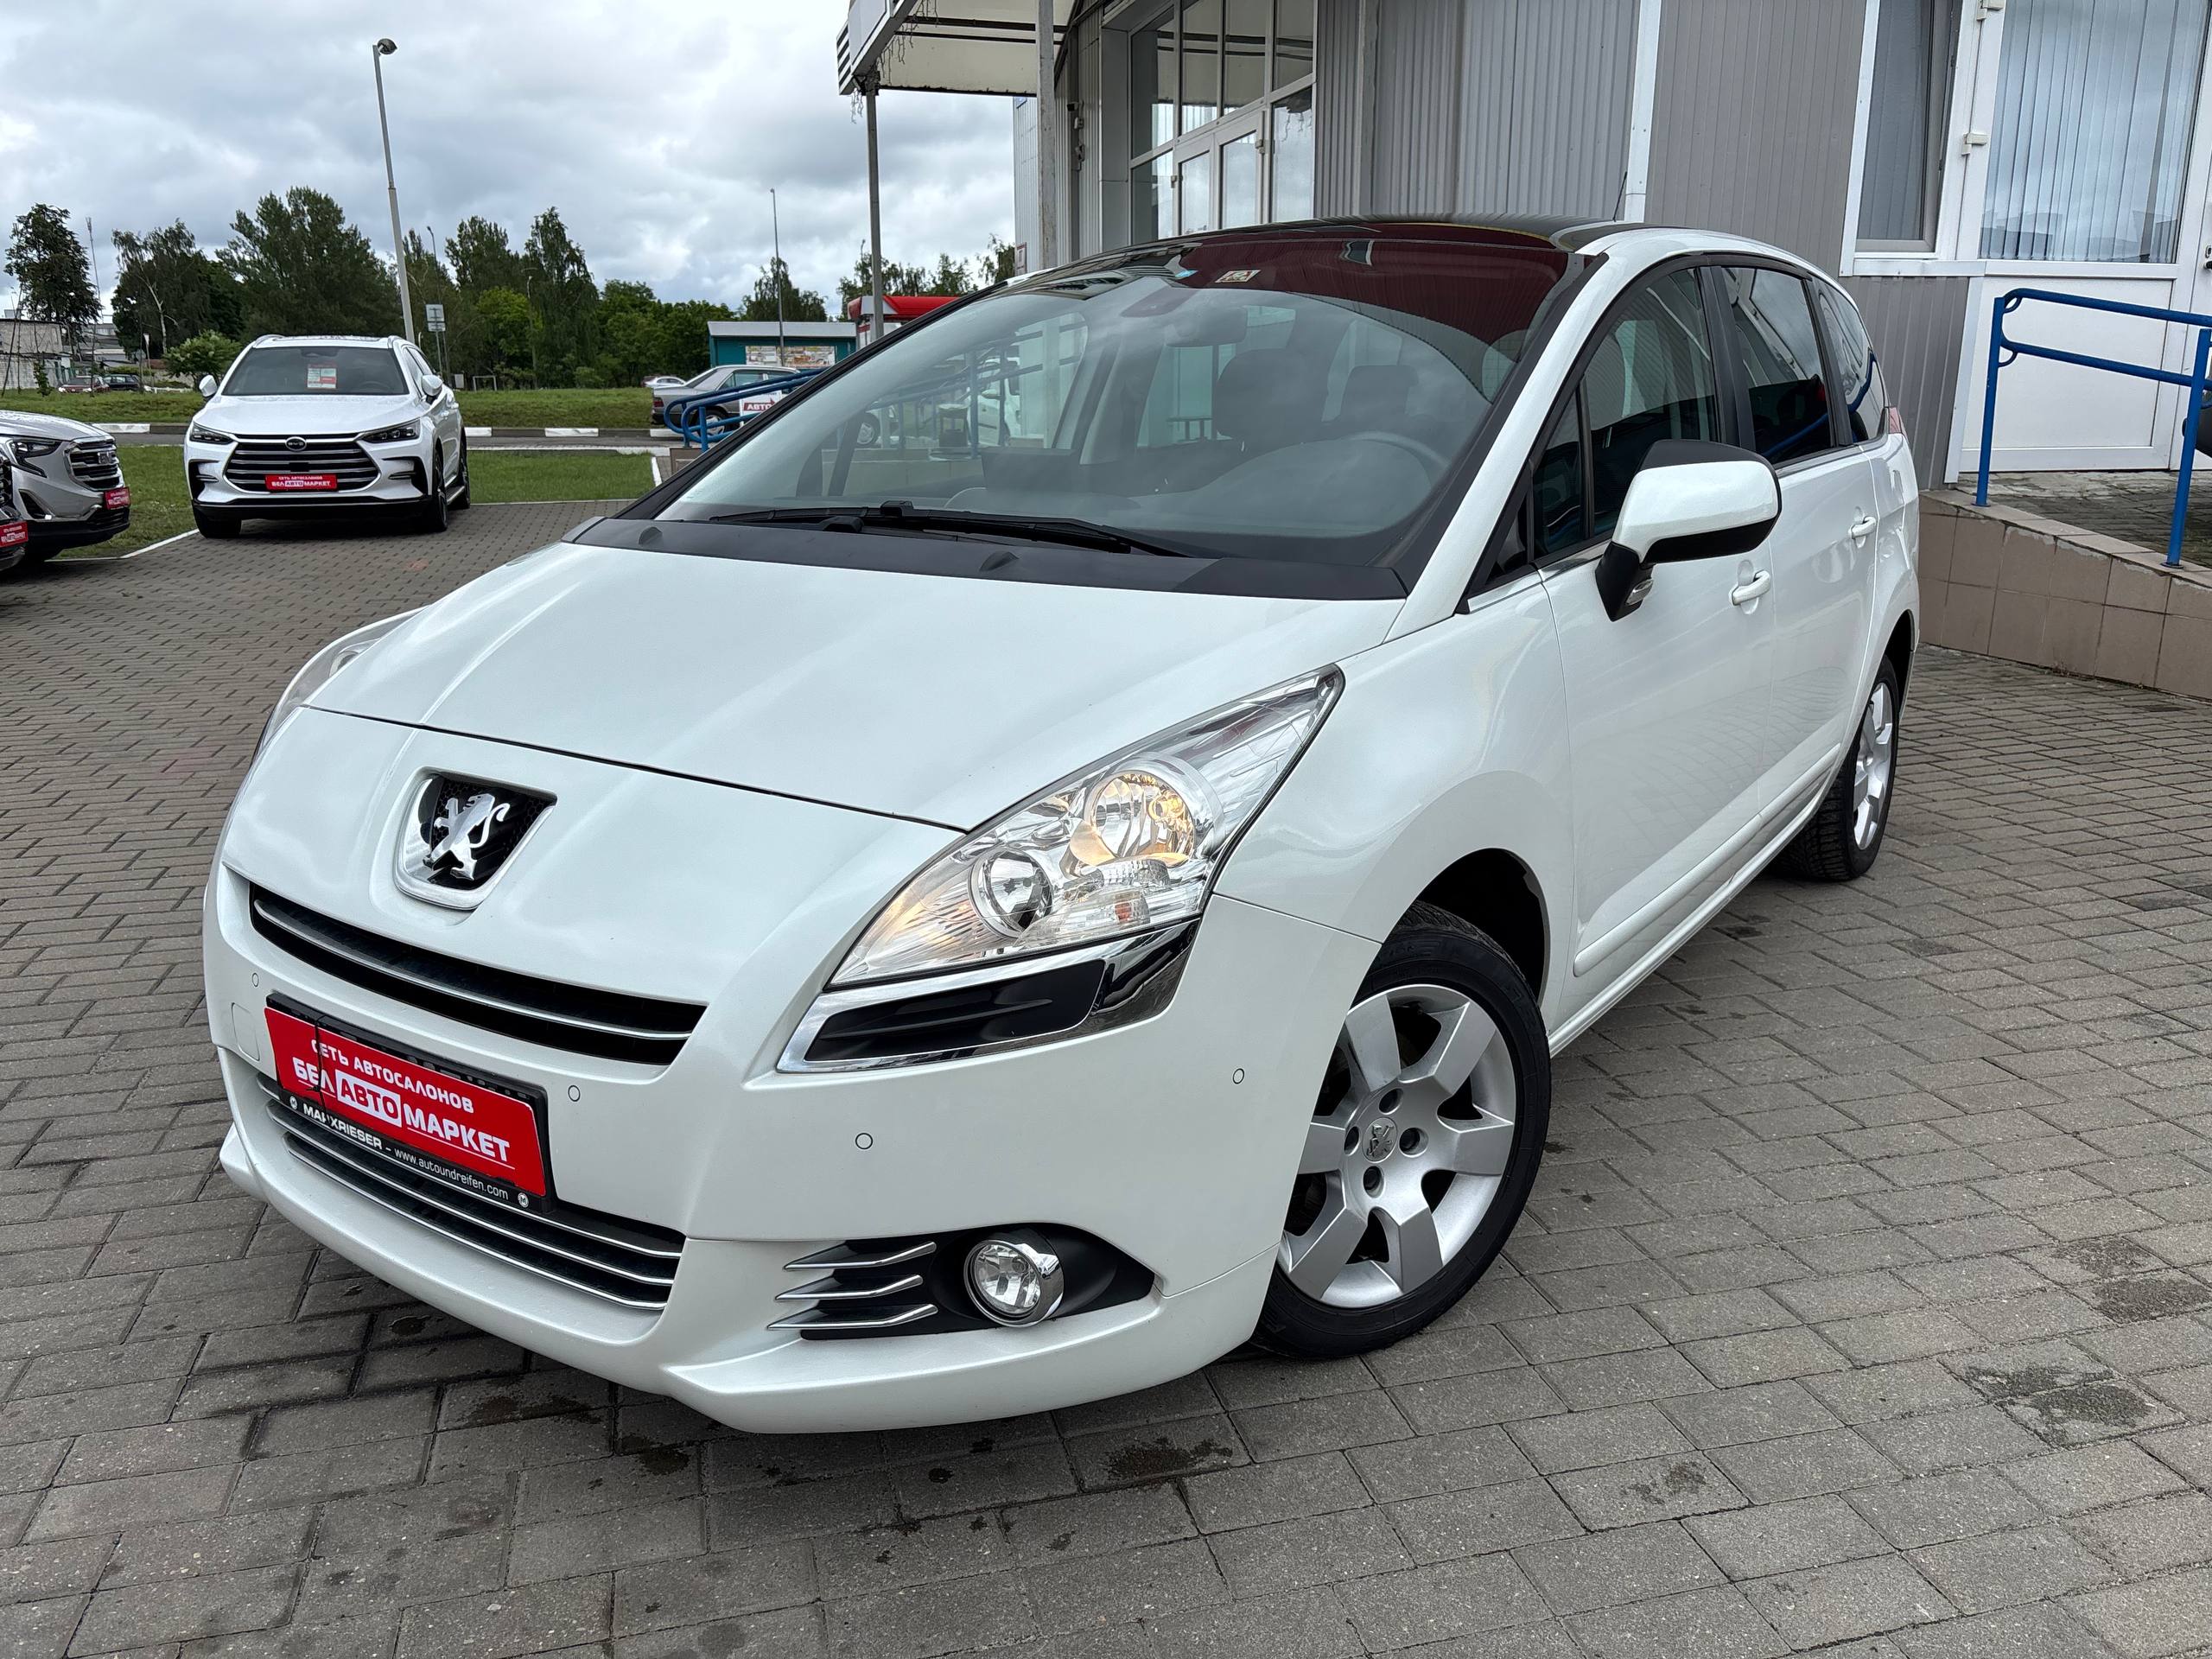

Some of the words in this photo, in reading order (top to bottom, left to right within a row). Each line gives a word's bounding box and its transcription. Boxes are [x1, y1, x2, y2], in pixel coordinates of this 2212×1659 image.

[311, 1039, 349, 1066] СЕТЬ
[353, 1056, 474, 1114] АВТОСАЛОНОВ
[394, 1147, 509, 1200] www.autoundreifen.com
